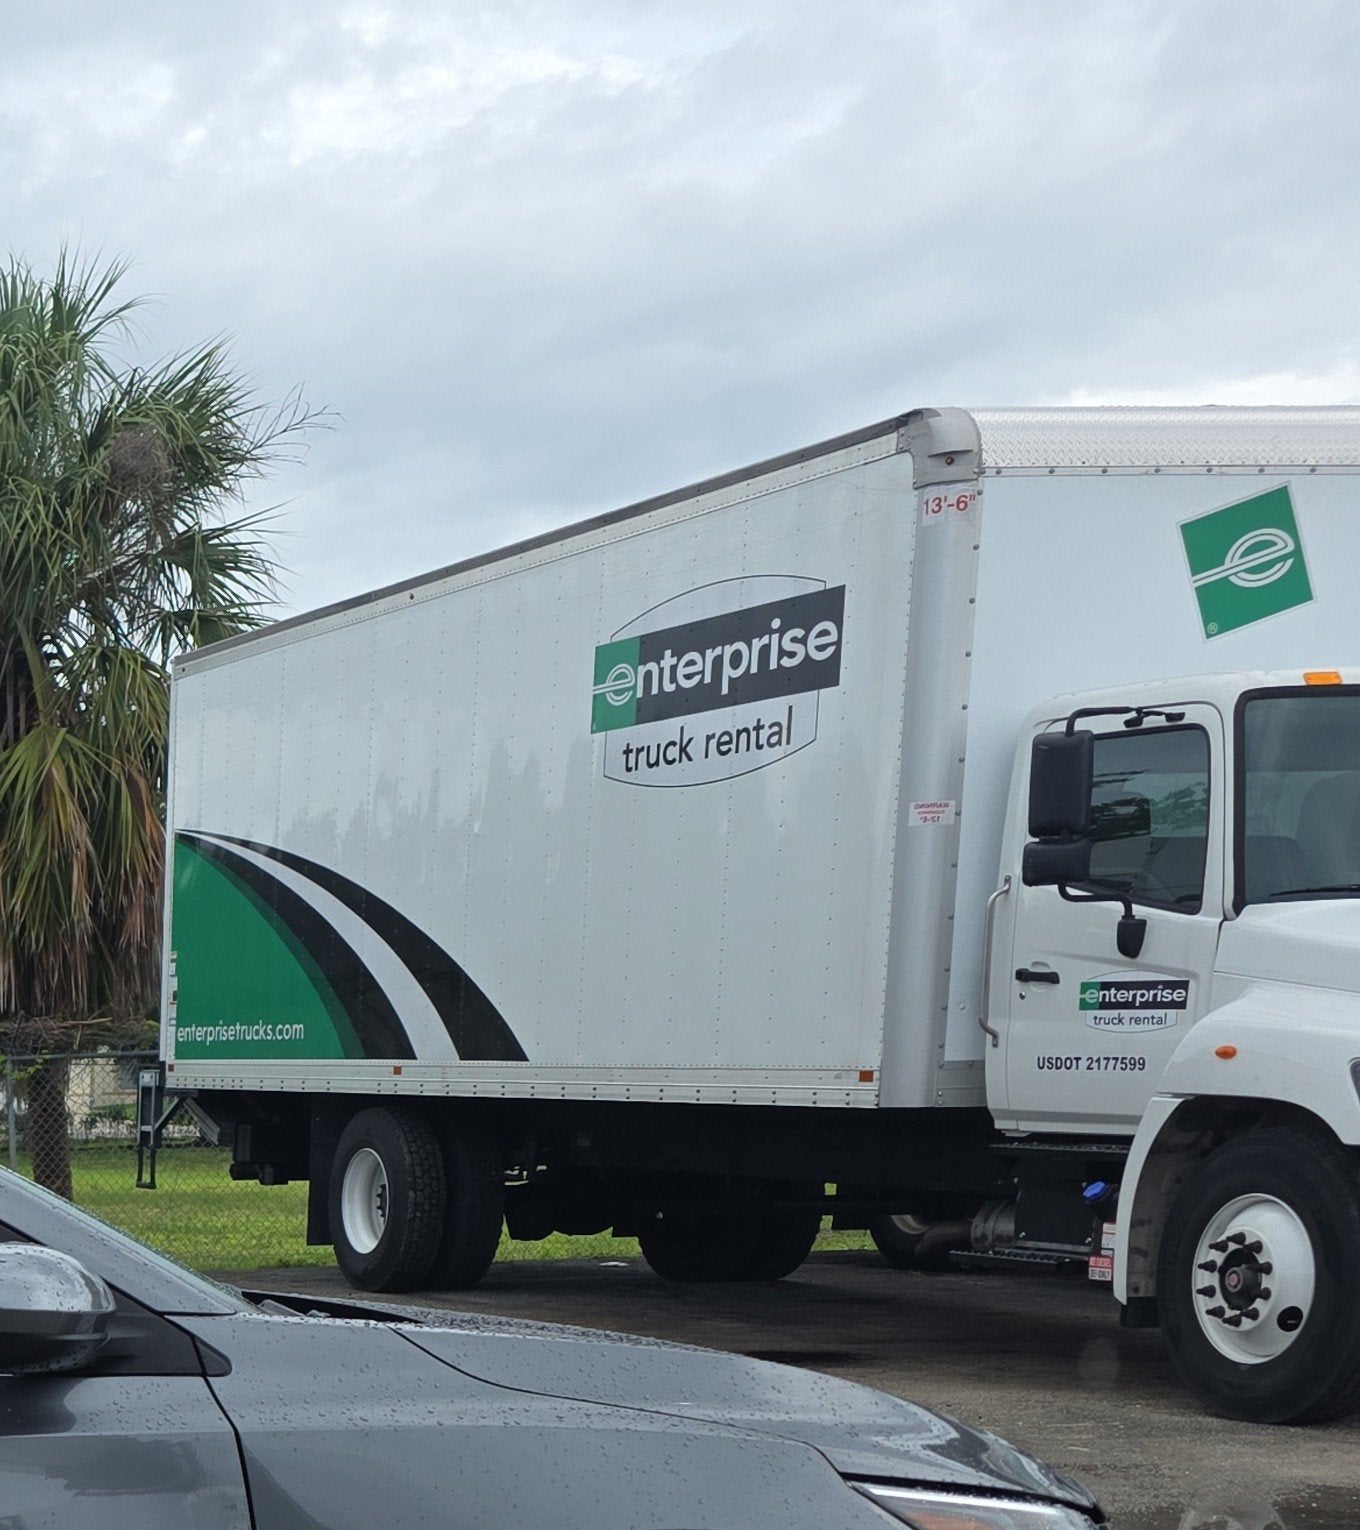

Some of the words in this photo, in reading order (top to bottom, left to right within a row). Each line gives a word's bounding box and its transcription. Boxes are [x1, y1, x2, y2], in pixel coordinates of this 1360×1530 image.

[593, 617, 839, 707] enterprise
[622, 725, 694, 773] truck
[704, 705, 793, 759] rental
[1081, 984, 1187, 1007] enterprise
[1093, 1012, 1124, 1026] truck
[1129, 1012, 1168, 1026] rental
[177, 1019, 305, 1046] enterprisetrucks.com
[1037, 1056, 1082, 1071] USDOT
[1086, 1056, 1147, 1071] 2177599
